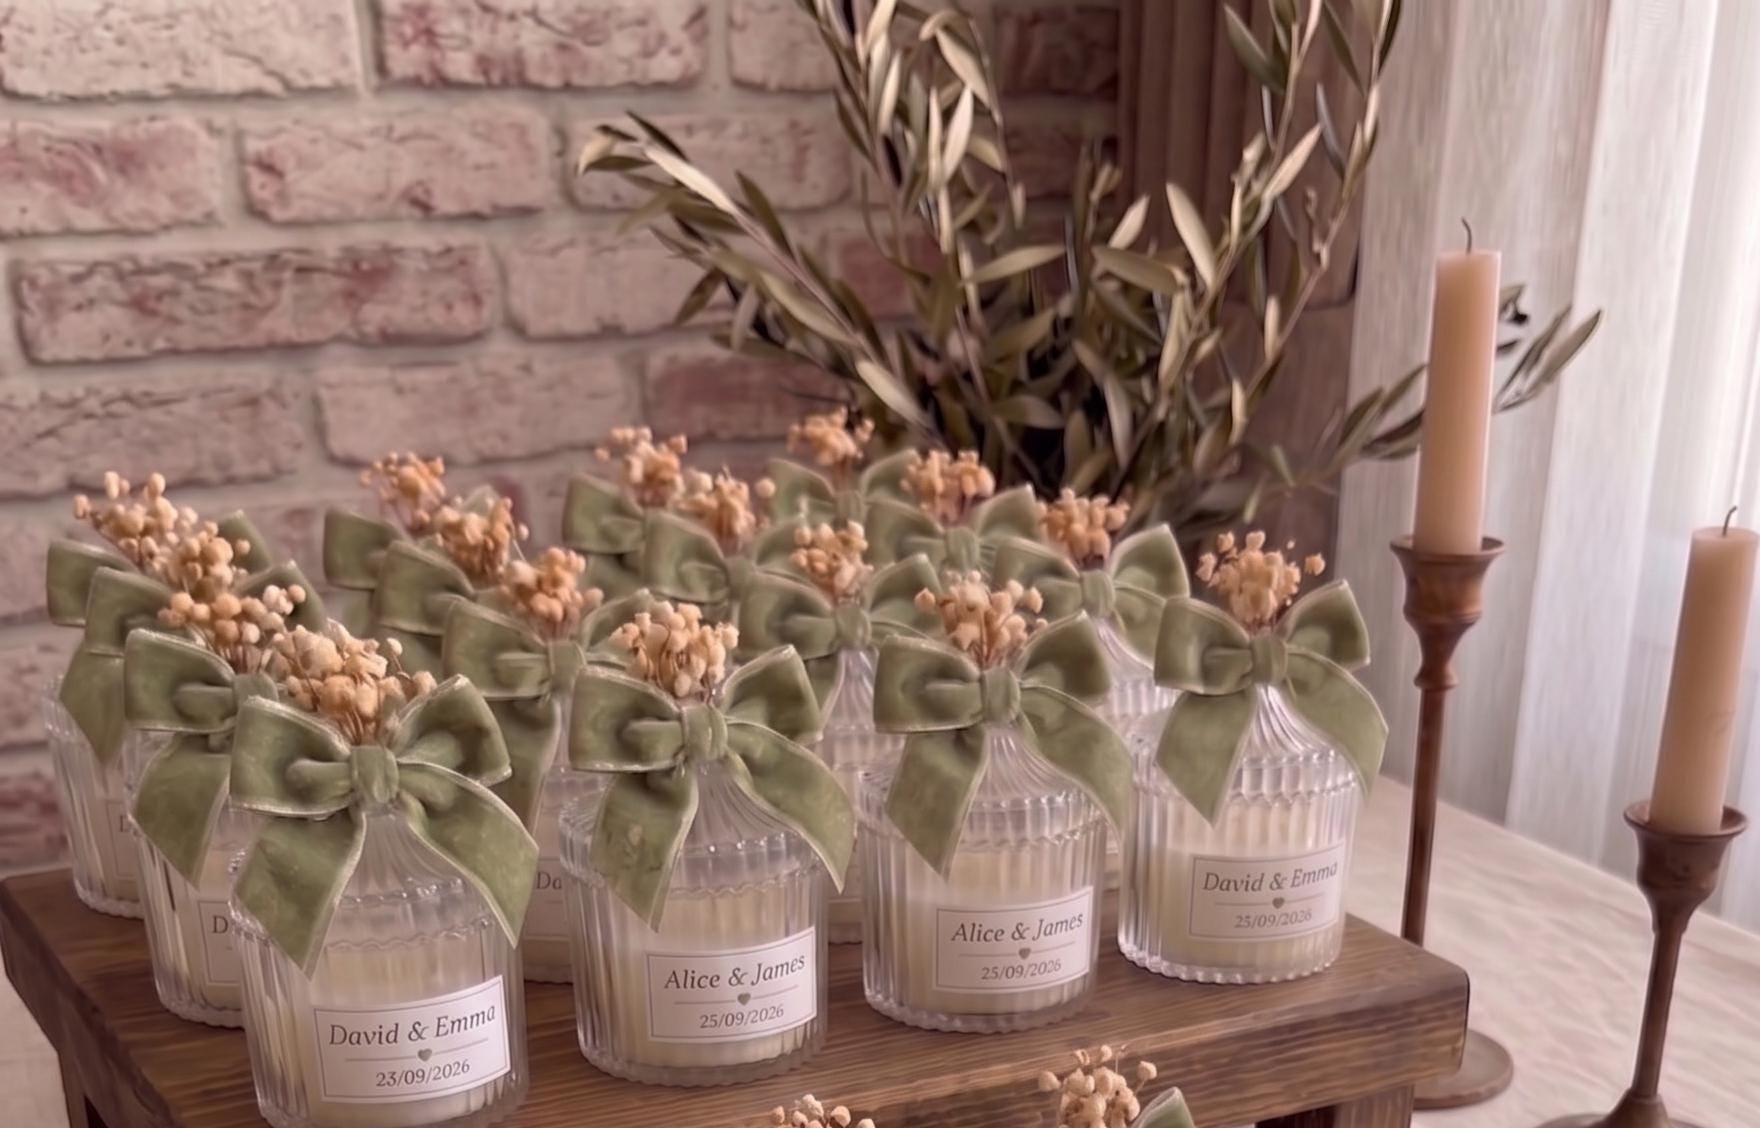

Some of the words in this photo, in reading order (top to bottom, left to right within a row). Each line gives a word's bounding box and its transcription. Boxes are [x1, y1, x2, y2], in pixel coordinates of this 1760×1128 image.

[1203, 871, 1265, 892] David
[1269, 872, 1288, 891] &
[1290, 862, 1338, 889] Emma
[951, 922, 1005, 942] Alice
[1011, 922, 1030, 941] &
[1032, 913, 1084, 942] James
[664, 969, 721, 989] Alice
[728, 967, 748, 987] &
[751, 955, 805, 986] James
[981, 958, 1062, 980] 25/09/2026
[329, 1022, 399, 1046] David
[408, 1021, 429, 1041] &
[434, 1005, 496, 1038] Emma
[699, 1004, 784, 1029] 25/09/2026
[376, 1059, 470, 1087] 23/09/2026
